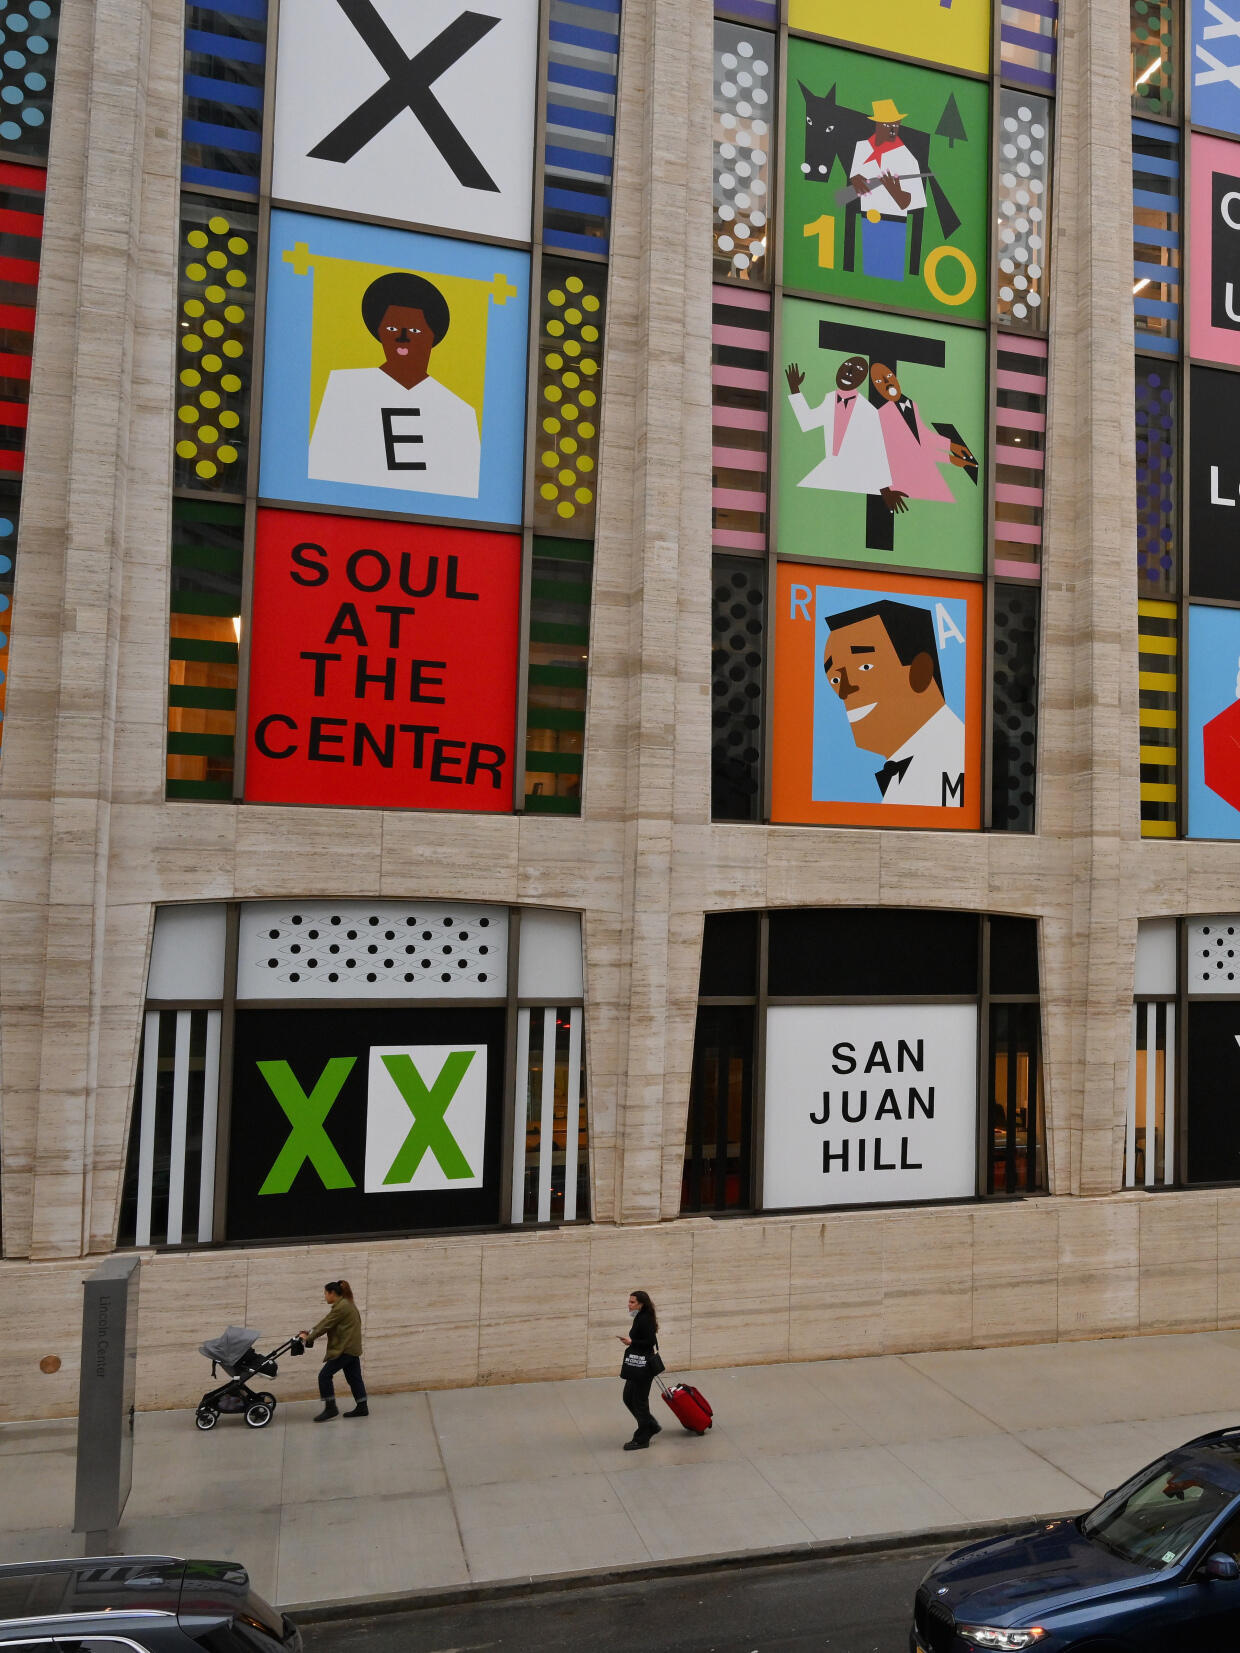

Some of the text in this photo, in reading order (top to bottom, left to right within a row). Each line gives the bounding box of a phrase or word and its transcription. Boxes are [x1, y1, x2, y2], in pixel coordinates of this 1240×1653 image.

[306, 0, 502, 193] X
[380, 407, 427, 471] E
[290, 543, 479, 601] SOUL
[324, 603, 415, 649] AT
[790, 584, 965, 649] R A
[300, 651, 447, 704] THE
[254, 713, 506, 789] CENTER
[941, 771, 965, 808] M
[831, 1038, 924, 1076] SAN
[809, 1086, 936, 1124] JUAN
[821, 1137, 923, 1174] HILL
[97, 1296, 111, 1377] Lincoln Center
